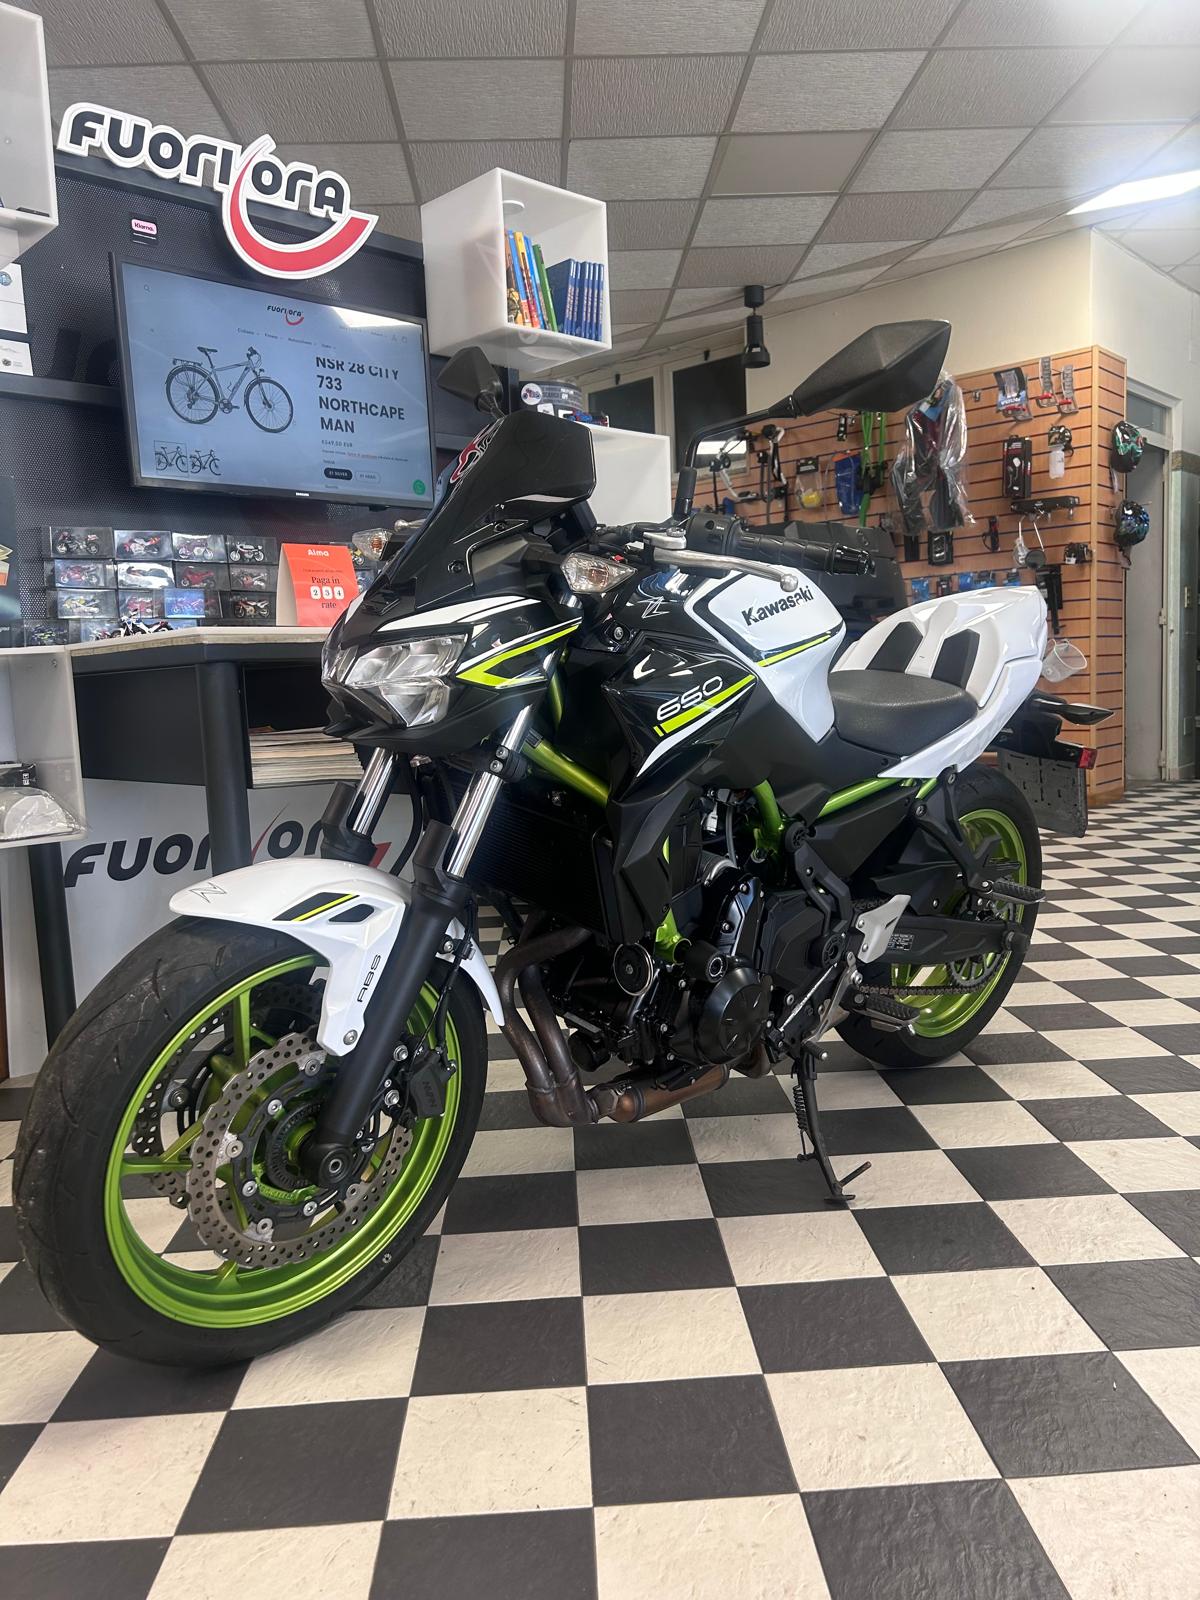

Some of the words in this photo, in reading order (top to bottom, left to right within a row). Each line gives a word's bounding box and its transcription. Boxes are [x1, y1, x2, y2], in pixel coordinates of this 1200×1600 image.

[317, 375, 342, 390] 733
[319, 396, 405, 420] NORTHCAPE
[320, 417, 355, 434] MAN
[307, 549, 330, 557] Alma
[311, 577, 330, 585] Paga
[332, 576, 340, 584] in
[742, 586, 814, 626] Kawasaki
[657, 675, 723, 721] 650
[357, 953, 381, 1003] ABS
